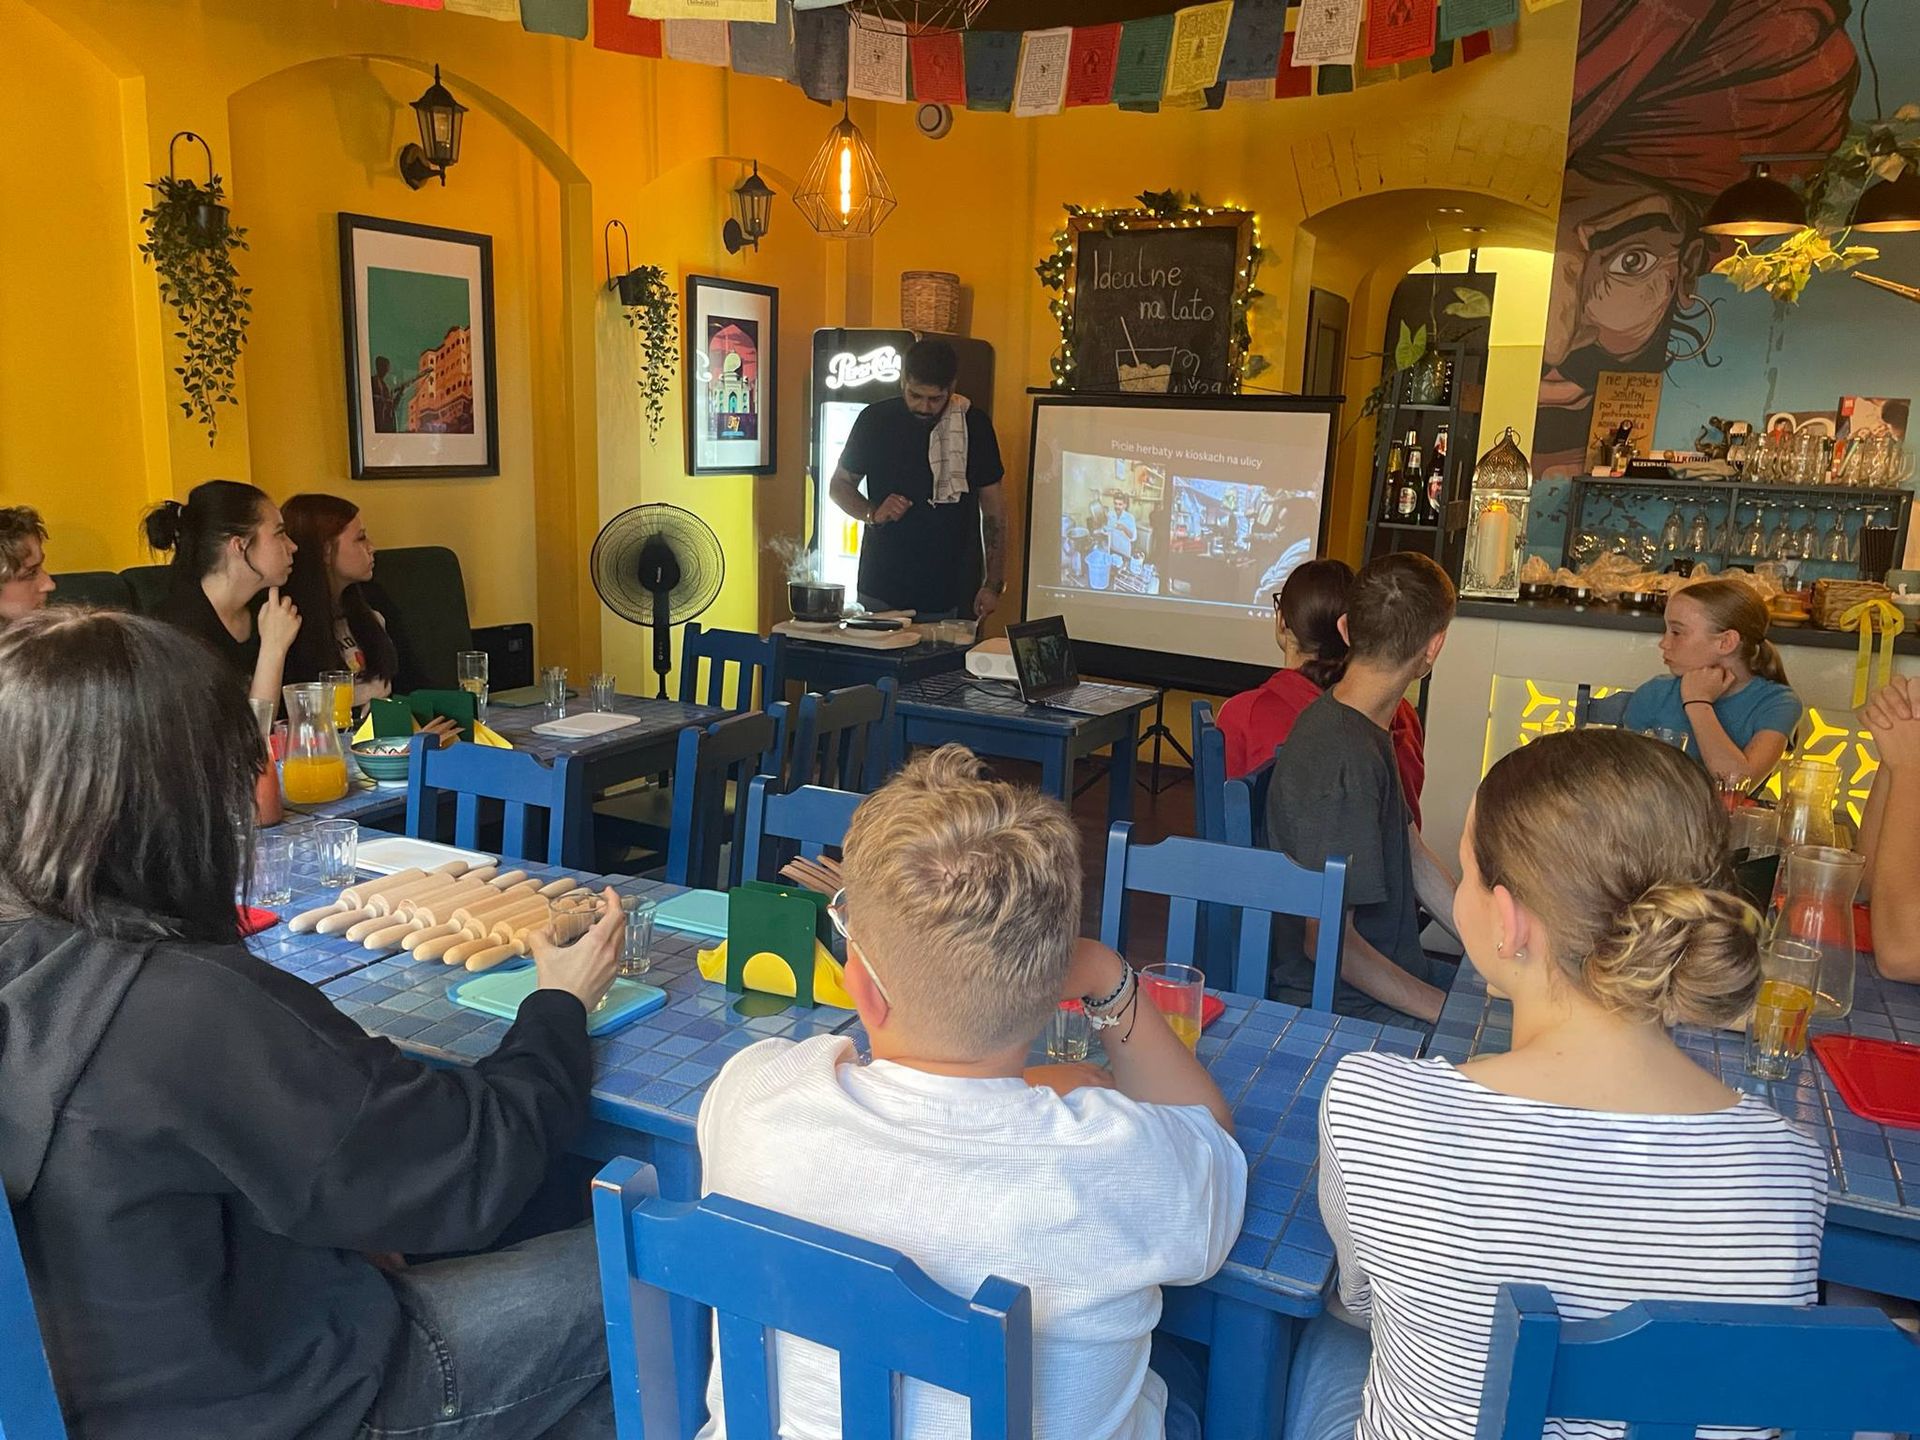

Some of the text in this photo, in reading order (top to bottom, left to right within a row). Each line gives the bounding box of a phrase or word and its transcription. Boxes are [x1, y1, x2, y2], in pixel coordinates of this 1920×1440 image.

[1093, 247, 1183, 290] Idealne
[1139, 289, 1215, 322] na lato
[1111, 440, 1135, 452] Picie
[1136, 443, 1173, 459] herbaty
[1185, 449, 1225, 463] kioskach
[1226, 456, 1238, 465] na
[1240, 457, 1264, 469] ulicy
